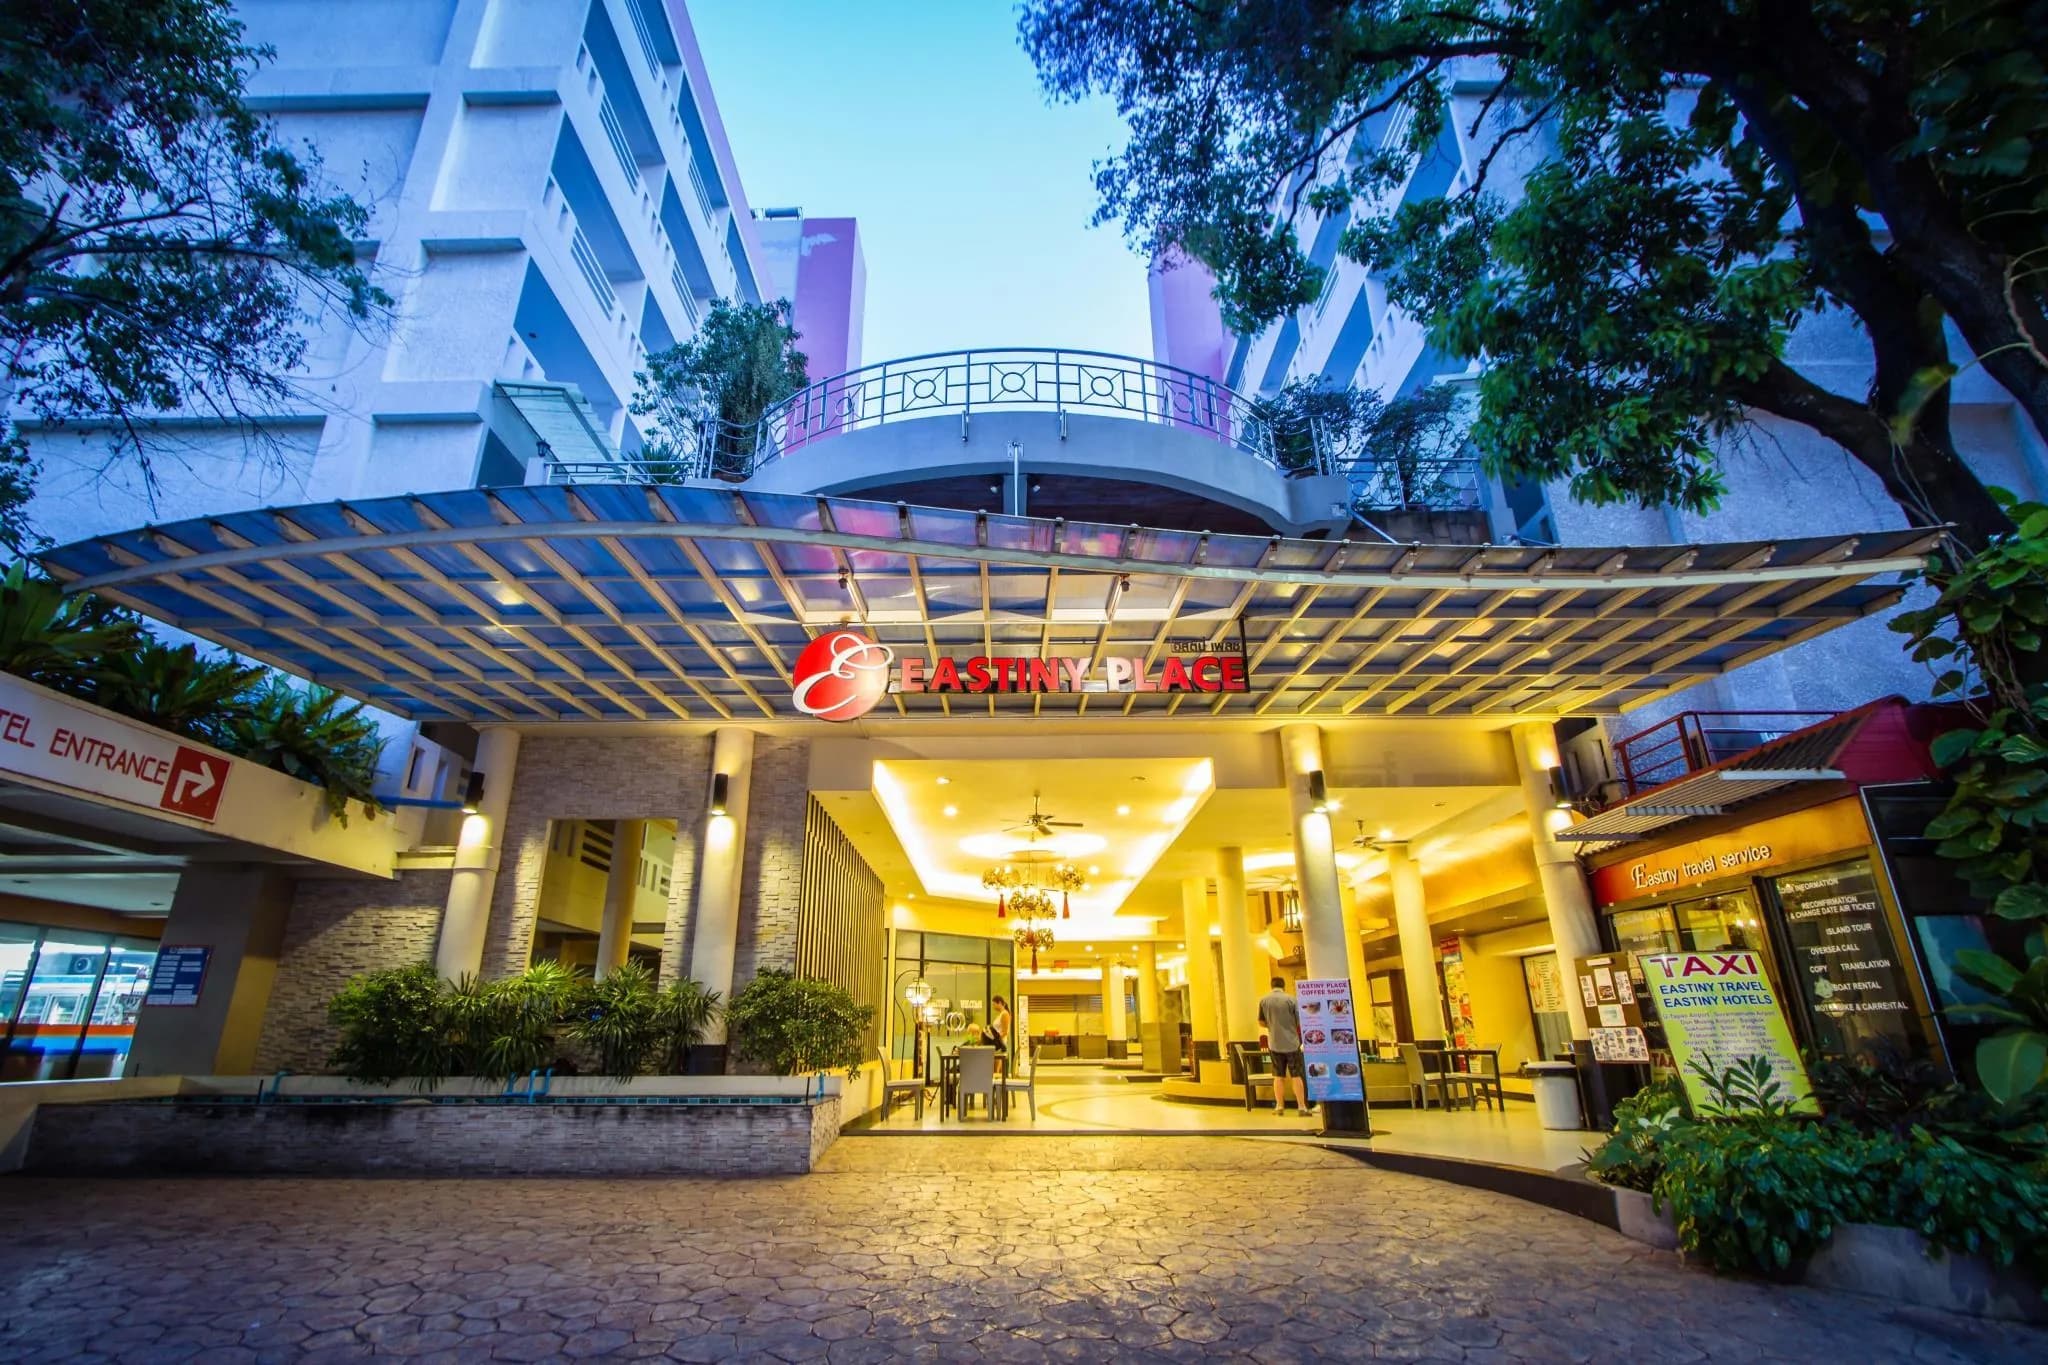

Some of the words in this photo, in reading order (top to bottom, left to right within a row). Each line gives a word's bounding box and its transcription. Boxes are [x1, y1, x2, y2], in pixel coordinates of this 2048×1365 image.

[900, 656, 1091, 693] EASTINY
[1105, 656, 1247, 693] PLACE
[49, 728, 170, 785] ENTRANCE
[1631, 863, 1678, 890] Eastiny
[1683, 855, 1716, 877] travel
[1721, 845, 1771, 867] service
[1795, 909, 1821, 919] CHANGE
[1822, 906, 1838, 915] DATE
[1839, 905, 1852, 913] AIR
[1853, 902, 1876, 911] TICKET
[1826, 926, 1851, 936] ISLAND
[1852, 923, 1873, 932] TOUR
[1810, 945, 1841, 956] OVERSEA
[1841, 943, 1860, 952] CALL
[1649, 954, 1760, 979] TAXI
[1809, 965, 1828, 973] COPY
[1840, 960, 1891, 971] TRANSLATION
[1659, 982, 1714, 995] EASTINY
[1718, 981, 1767, 992] TRAVEL
[1833, 982, 1851, 992] BOAT
[1853, 980, 1882, 990] RENTAL
[1664, 995, 1718, 1008] EASTINY
[1723, 994, 1772, 1006] HOTELS
